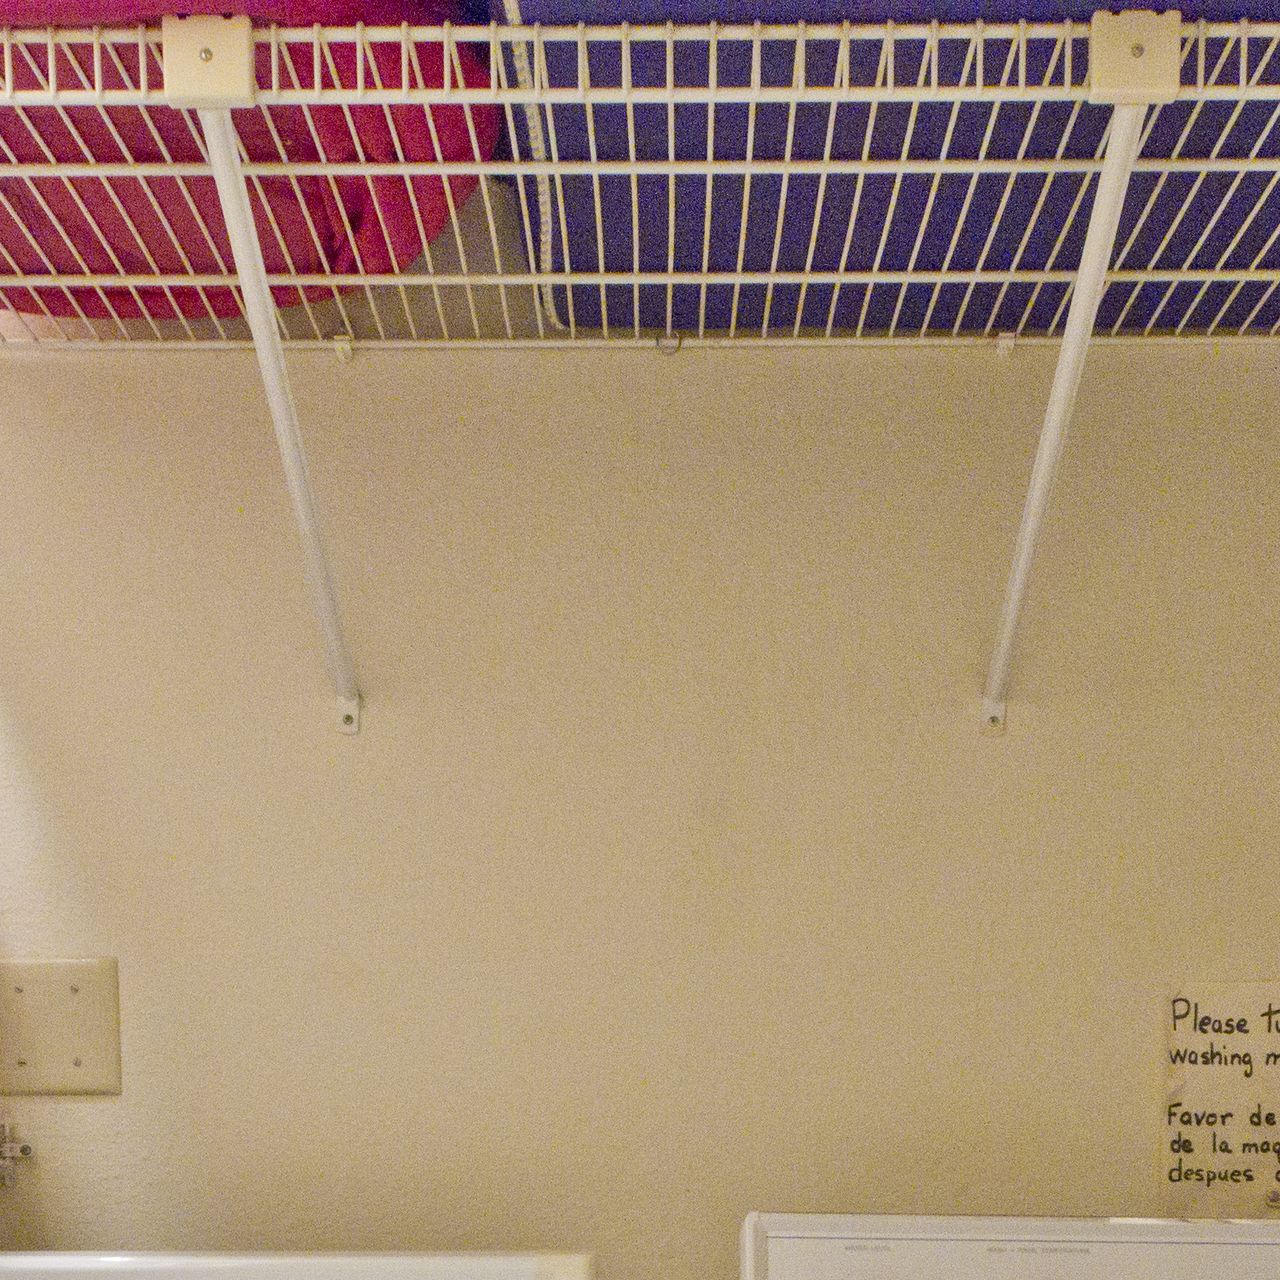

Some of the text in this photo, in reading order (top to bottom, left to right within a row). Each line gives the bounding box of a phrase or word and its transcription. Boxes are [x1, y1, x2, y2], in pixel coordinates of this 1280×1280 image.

[1172, 998, 1249, 1034] Please
[1170, 1042, 1253, 1078] washing
[1168, 1102, 1233, 1126] Favor
[1249, 1103, 1276, 1126] de
[1170, 1131, 1193, 1153] de
[1213, 1131, 1233, 1154] la
[1169, 1158, 1254, 1188] despues
